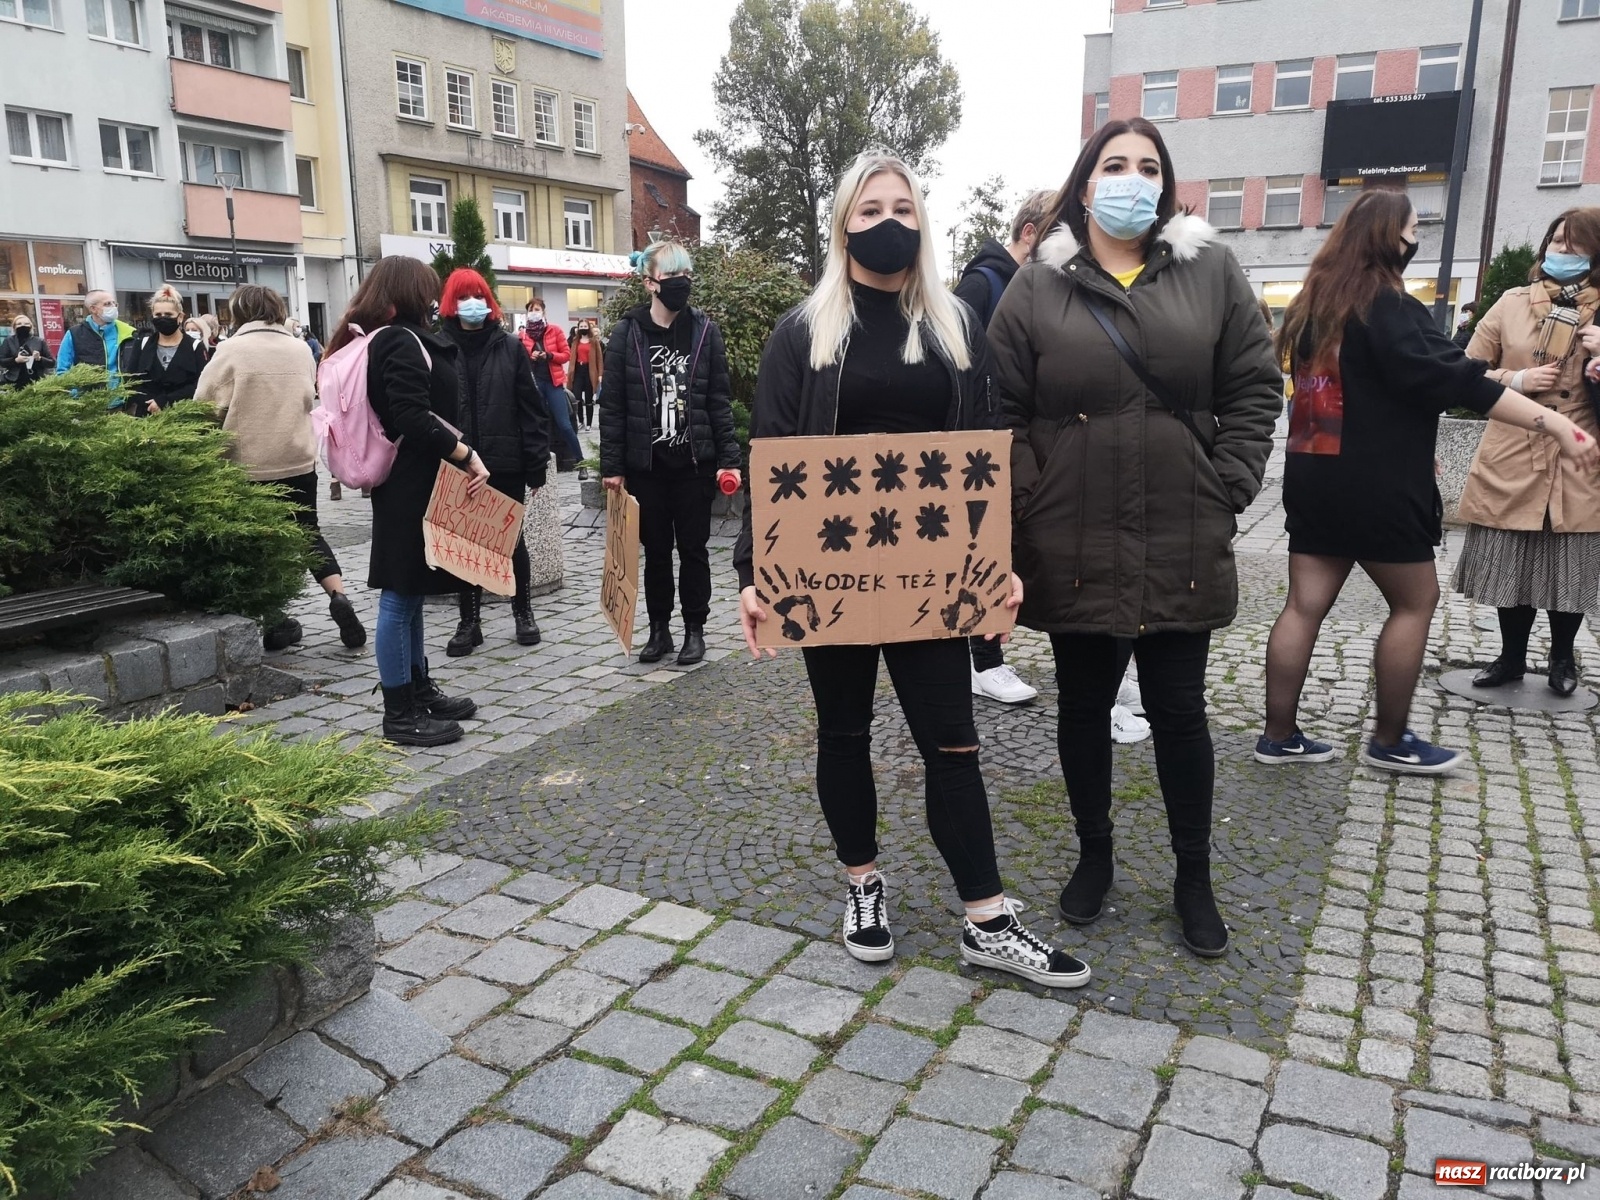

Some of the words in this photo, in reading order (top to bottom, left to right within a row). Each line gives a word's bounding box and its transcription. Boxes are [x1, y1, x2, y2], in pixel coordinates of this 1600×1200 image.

[481, 6, 542, 30] AKADEMIA
[553, 27, 588, 44] WIEKU
[38, 263, 83, 275] empik.com
[434, 464, 461, 508] NIE
[808, 573, 886, 592] GODEK
